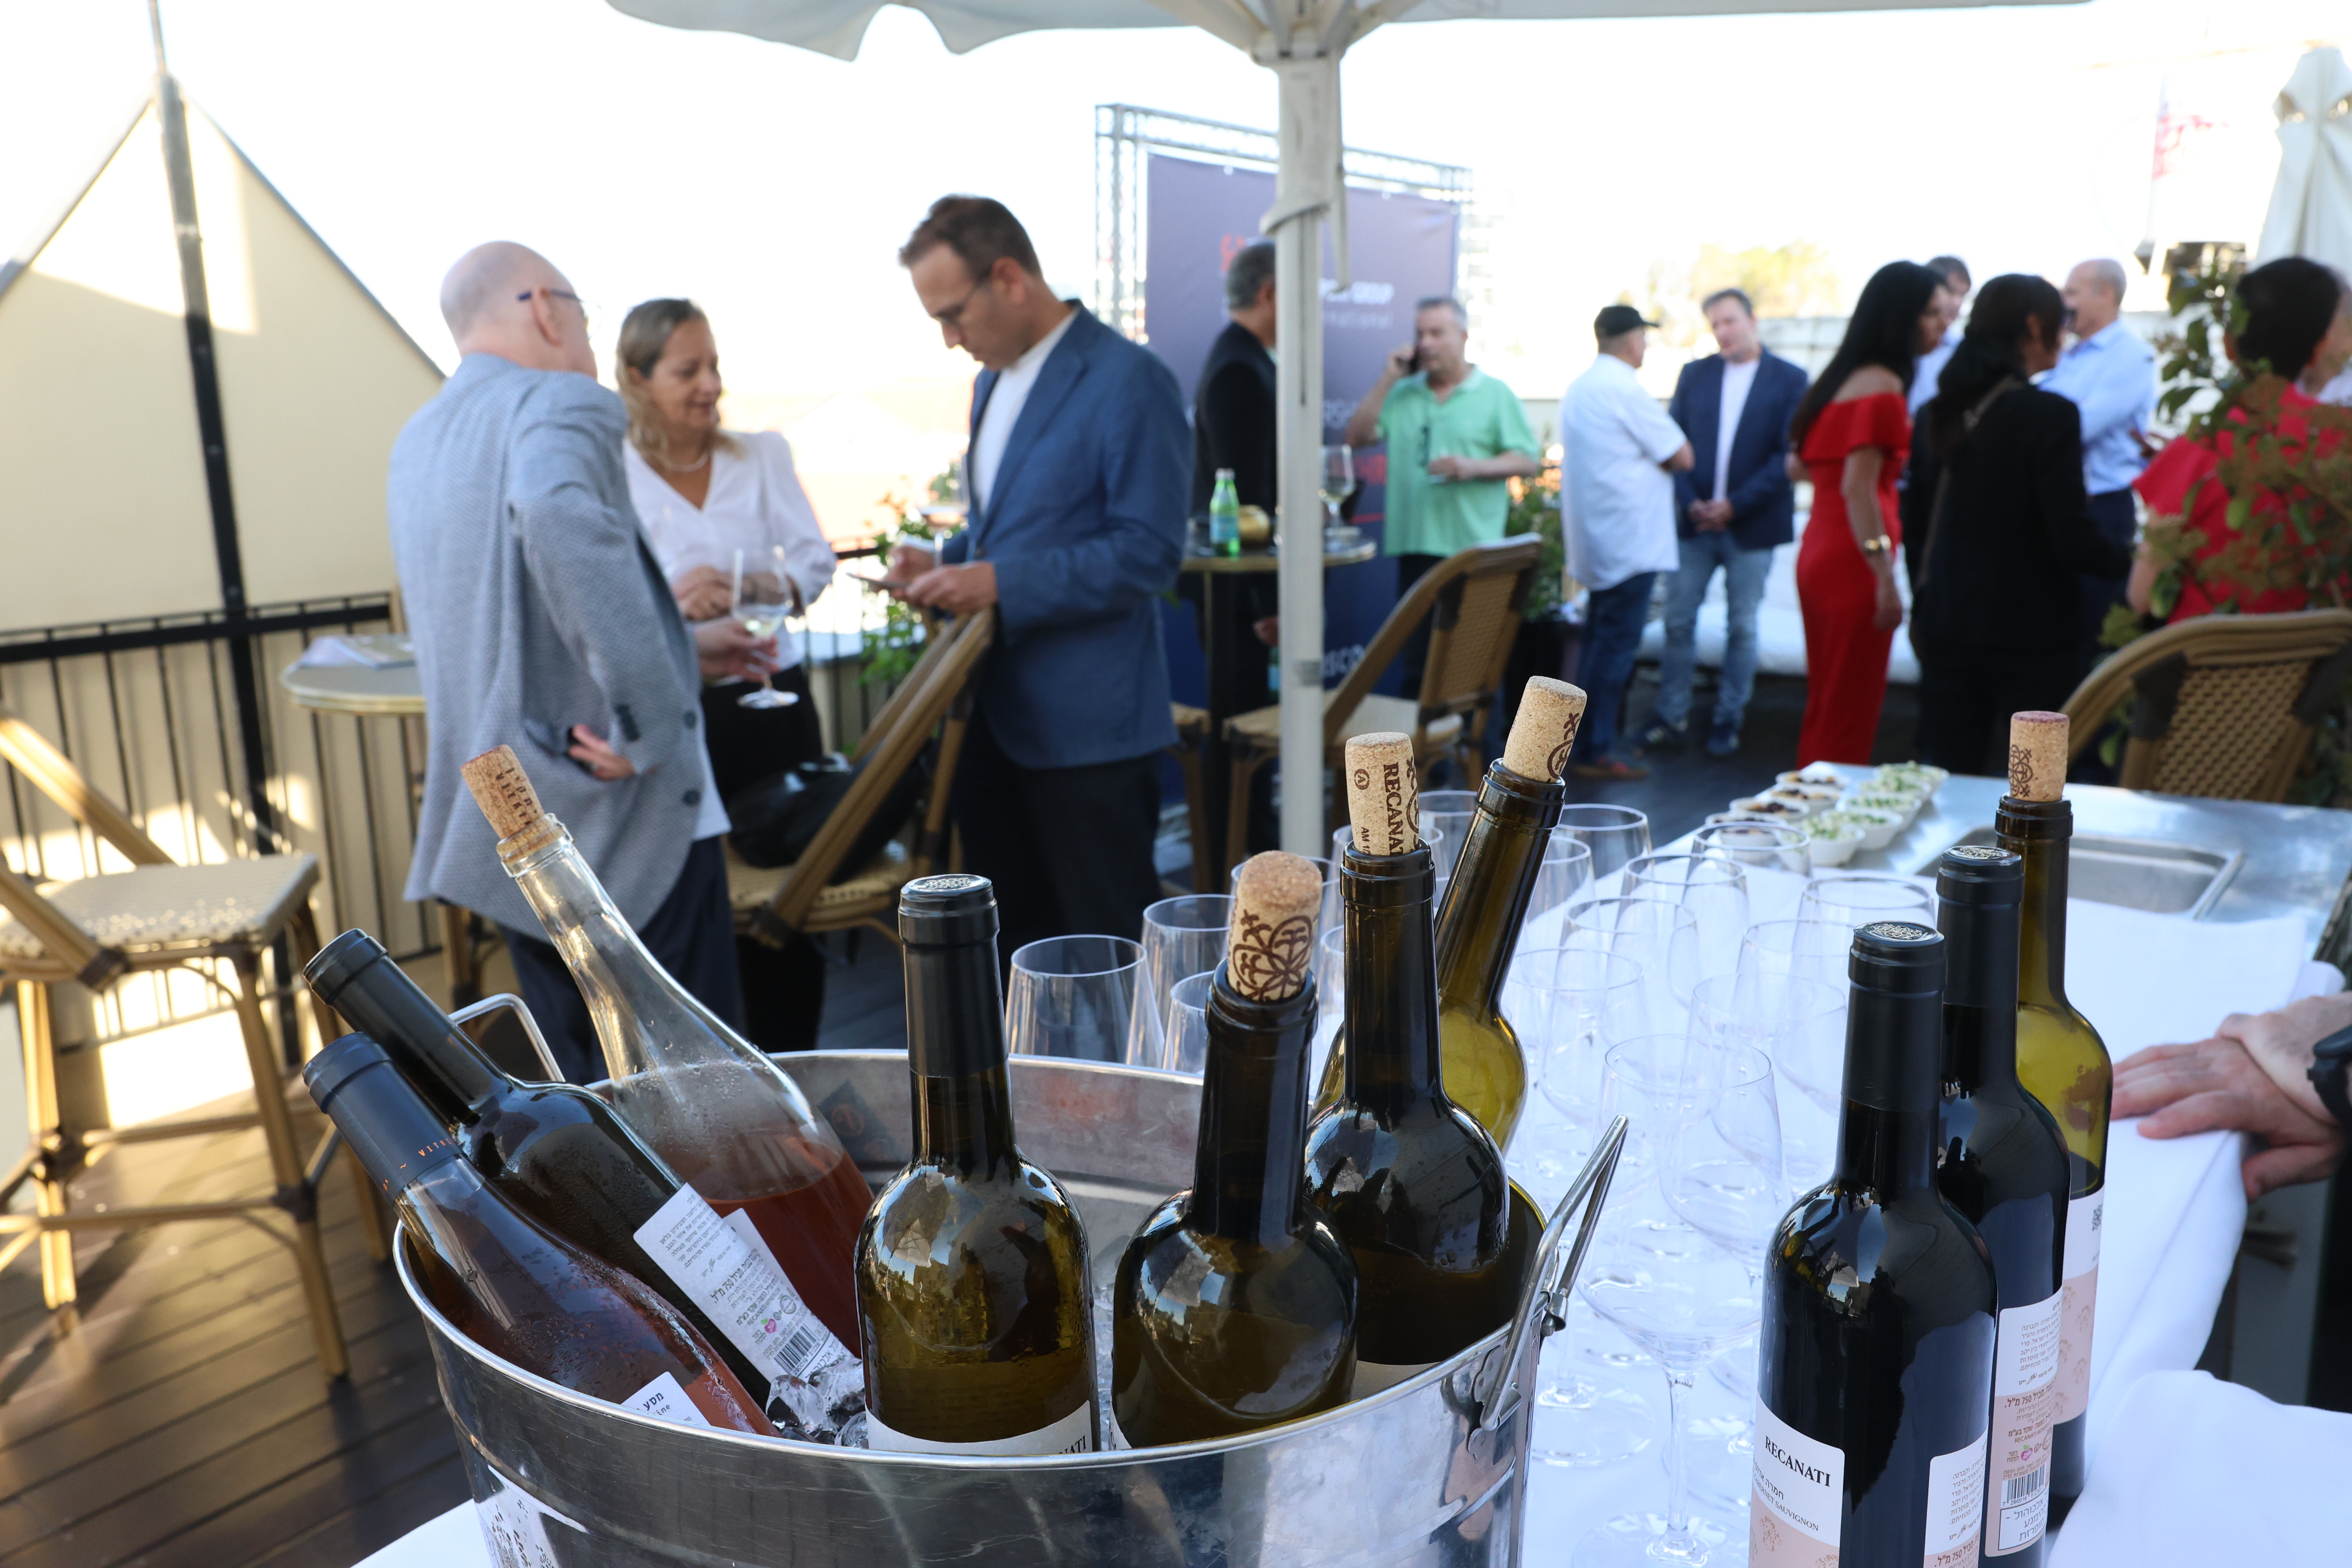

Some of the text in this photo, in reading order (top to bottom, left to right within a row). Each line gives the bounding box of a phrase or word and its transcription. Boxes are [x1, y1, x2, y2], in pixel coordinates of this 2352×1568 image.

[1384, 762, 1404, 855] RECANAT
[1361, 827, 1370, 842] AM
[659, 1233, 671, 1245] בלאן
[677, 1230, 686, 1239] אזור
[685, 1230, 698, 1243] שיתוף
[666, 1239, 677, 1251] הנגב
[671, 1243, 686, 1257] פעולה
[677, 1253, 686, 1262] שני
[729, 1268, 744, 1282] מכיל
[722, 1278, 734, 1291] 750
[747, 1302, 757, 1313] שקד
[2022, 1322, 2039, 1331] וקברנה
[2031, 1334, 2046, 1345] ישראל.
[2020, 1353, 2038, 1363] מוסדות
[792, 1357, 808, 1376] 290019
[643, 1392, 664, 1411] מסע
[2022, 1395, 2032, 1405] 750
[2033, 1389, 2044, 1401] מכיל
[656, 1403, 671, 1416] ine
[2016, 1411, 2035, 1421] לשמירת
[2023, 1425, 2033, 1434] שקד
[1765, 1435, 1831, 1487] RECANATI
[1953, 1467, 1970, 1480] וקברנה
[1766, 1478, 1784, 1500] חמרה
[1952, 1478, 1966, 1488] והגיר
[1962, 1480, 1976, 1494] ישראל.
[1951, 1498, 1961, 1507] יקב
[2010, 1496, 2027, 1505] 290019
[1950, 1502, 1969, 1516] מוסדות
[2014, 1497, 2043, 1520] אלכוהול
[1775, 1500, 1819, 1532] SAUVIGNON
[2019, 1518, 2044, 1541] מופרזת
[1963, 1540, 1975, 1555] מכיל
[1952, 1549, 1962, 1561] 750
